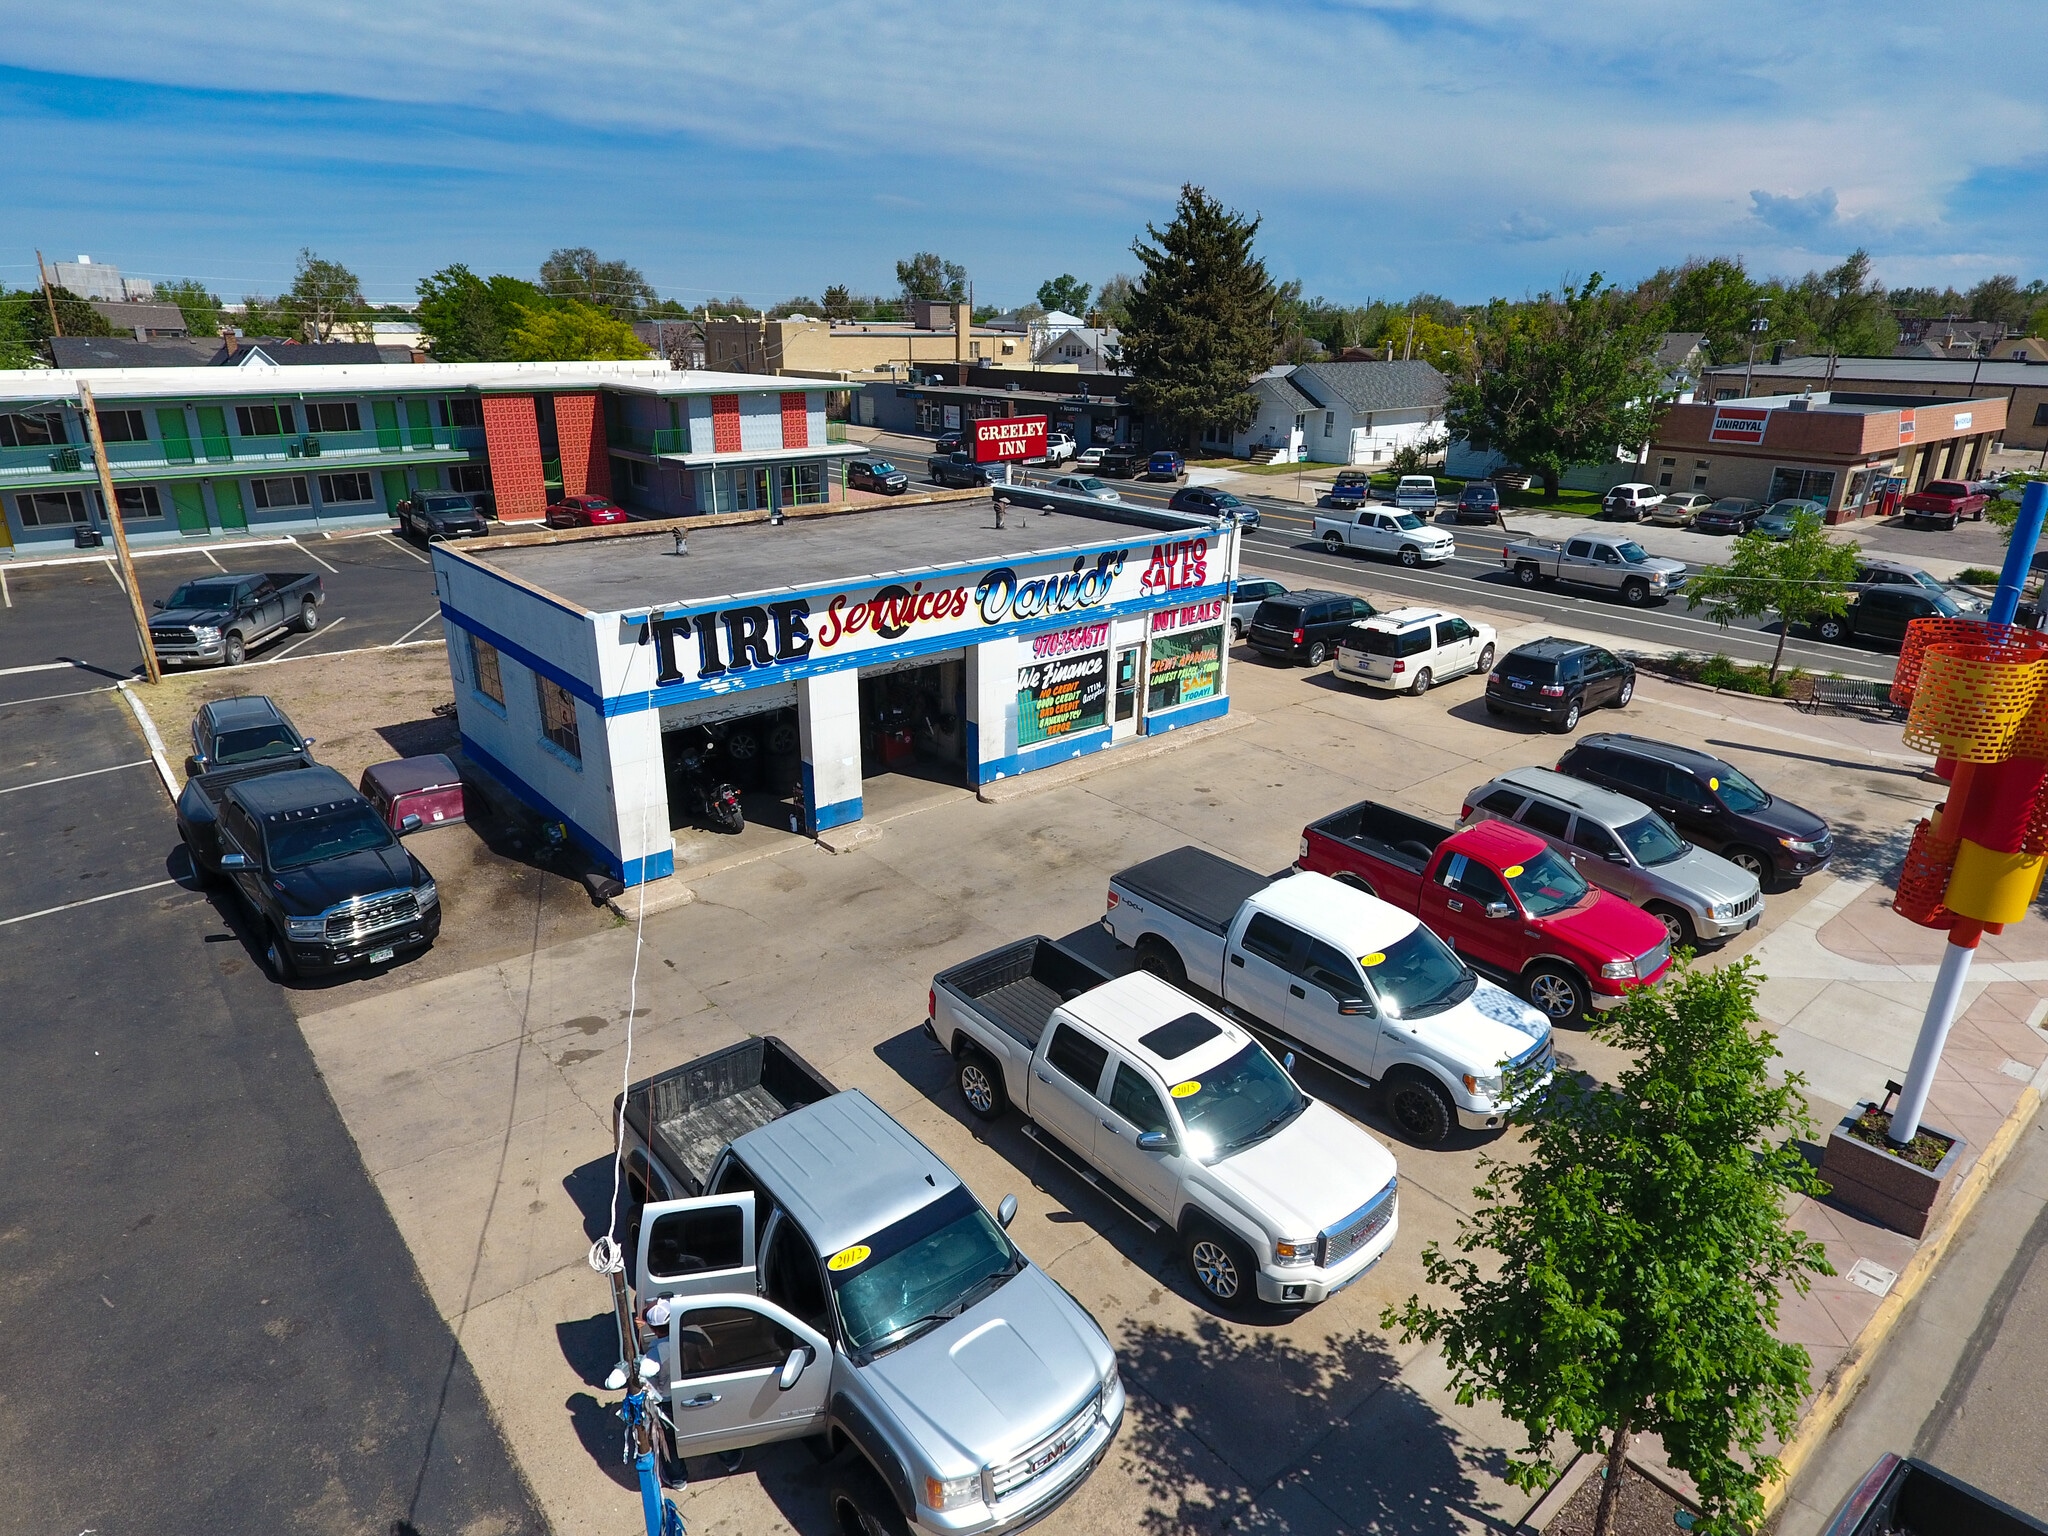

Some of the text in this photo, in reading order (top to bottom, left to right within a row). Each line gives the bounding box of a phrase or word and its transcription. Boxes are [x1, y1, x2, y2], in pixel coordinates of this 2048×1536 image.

[978, 422, 1046, 441] GREELEY
[1715, 419, 1763, 431] UNIROYAL
[999, 440, 1026, 456] INN
[1149, 538, 1208, 569] AUTO
[975, 549, 1129, 625] David's
[1140, 561, 1207, 597] SALES
[1153, 600, 1221, 632] HOT DEALS
[639, 582, 968, 687] TIRE Services
[1017, 657, 1103, 690] We Finance
[1150, 671, 1178, 686] LOWEST
[1036, 690, 1082, 709] GOOD CREDIT
[1040, 681, 1080, 699] NO CREDIT
[1184, 687, 1211, 700] TODAY!
[1038, 709, 1082, 728] BANKRUPTCY
[1040, 700, 1081, 719] BAD CREDIT
[1047, 721, 1071, 735] REPOS
[836, 1248, 863, 1268] 2012
